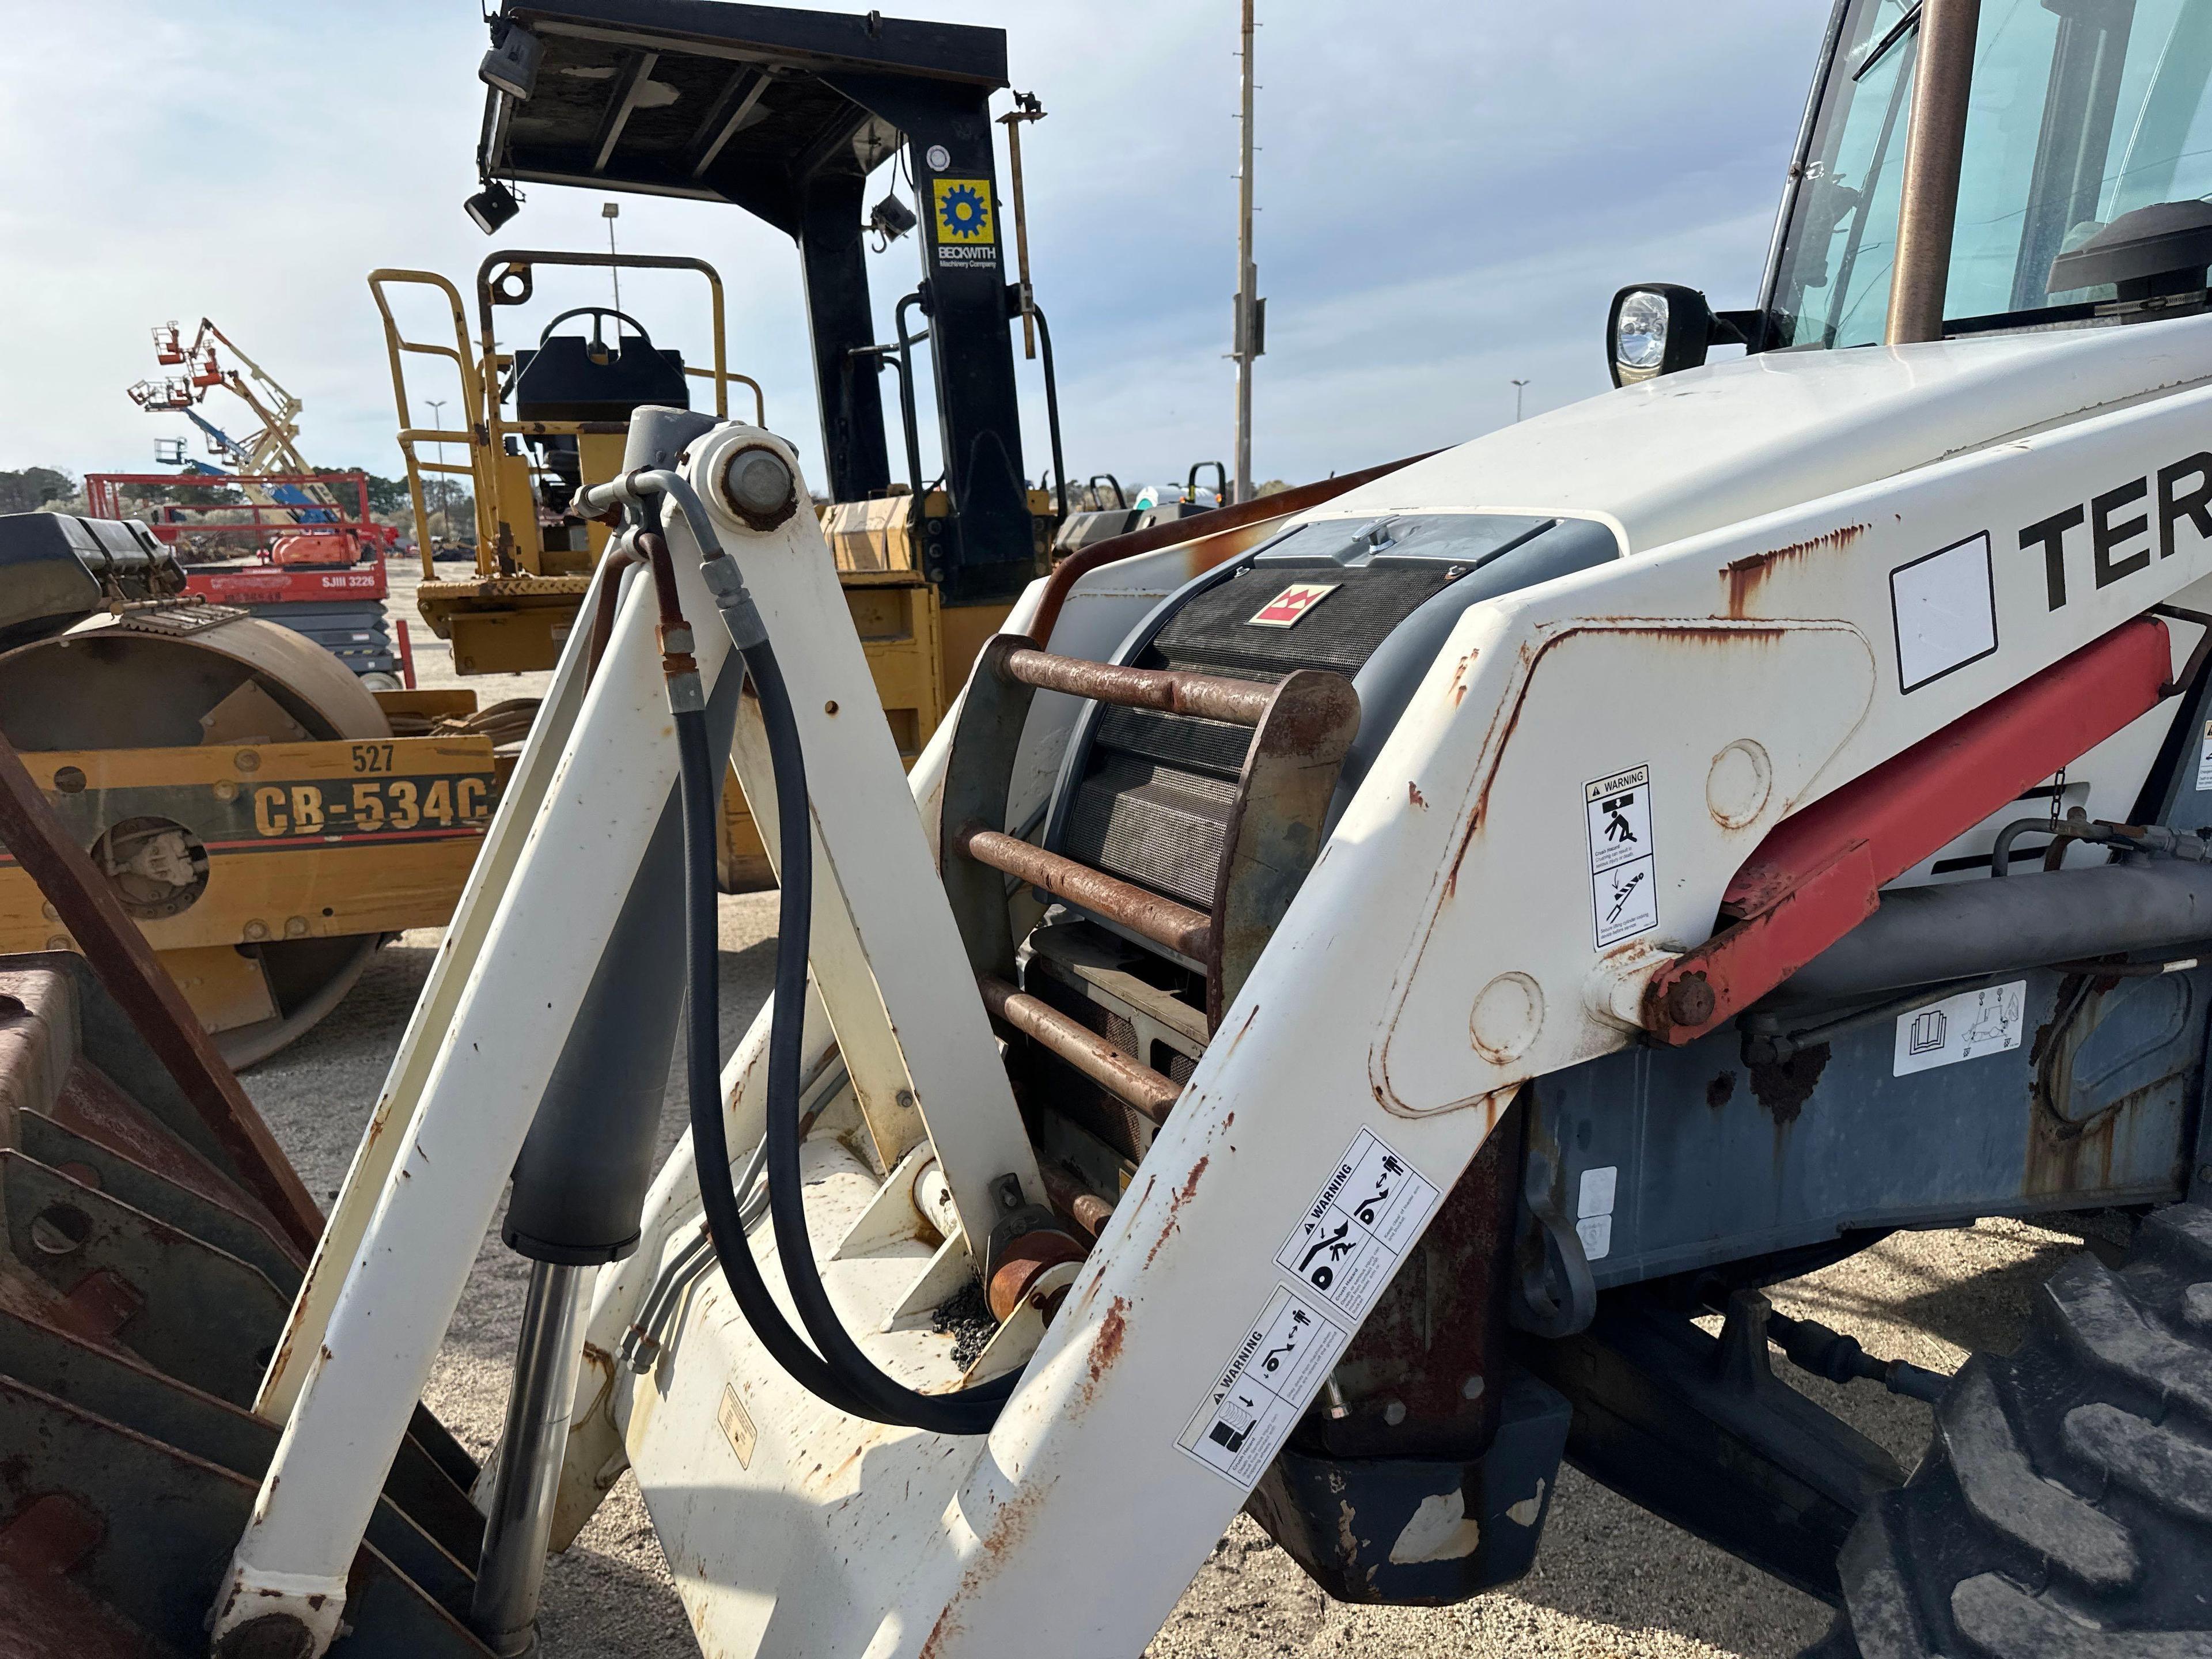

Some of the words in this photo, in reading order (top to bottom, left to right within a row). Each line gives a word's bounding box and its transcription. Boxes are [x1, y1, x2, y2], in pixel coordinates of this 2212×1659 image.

[938, 247, 996, 259] BECKWITH
[940, 260, 968, 269] Machinery
[969, 260, 997, 270] Company
[349, 575, 375, 586] 3226
[352, 745, 393, 772] 527
[1604, 771, 1642, 791] WARNING
[254, 777, 488, 837] CB-534C
[1310, 1162, 1353, 1219] WARNING
[1219, 1330, 1263, 1389] WARNING
